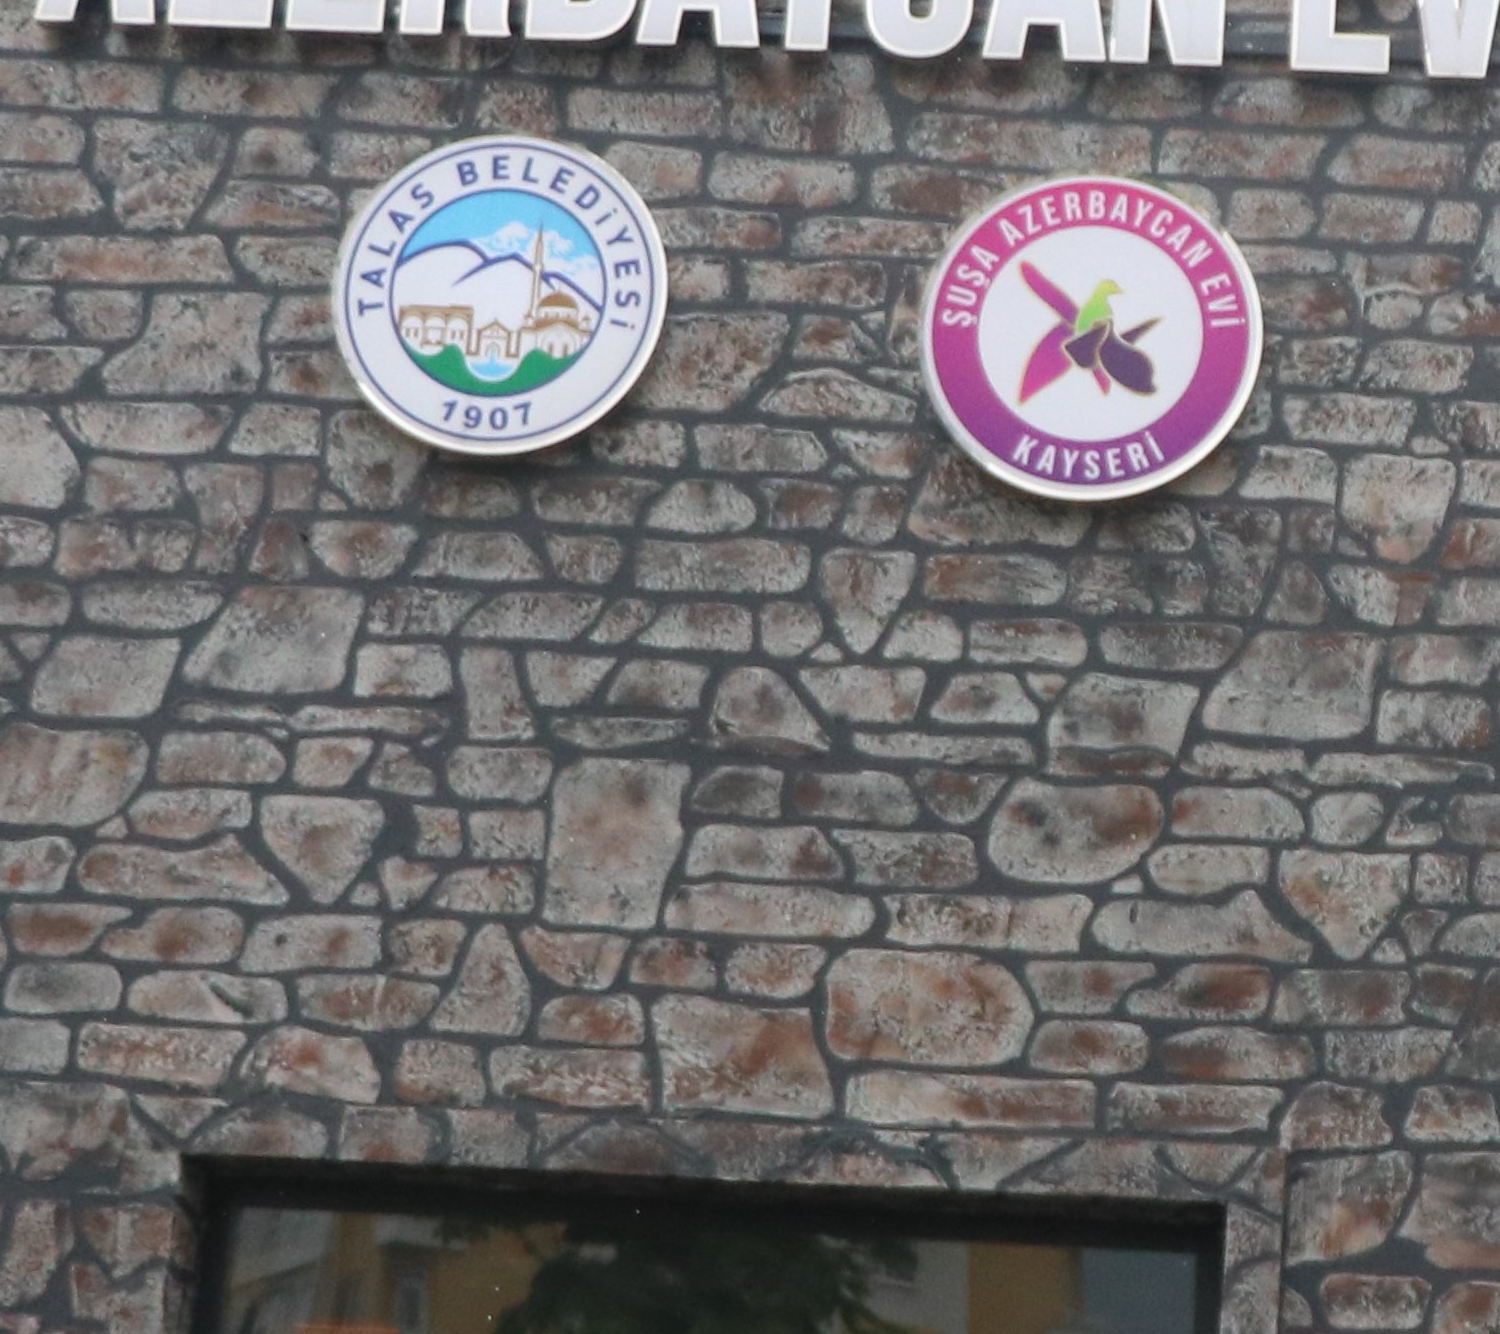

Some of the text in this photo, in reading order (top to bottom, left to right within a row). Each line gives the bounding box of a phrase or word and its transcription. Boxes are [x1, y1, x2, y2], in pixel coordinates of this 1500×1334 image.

[357, 182, 436, 317] TALAS
[940, 190, 1246, 329] ŞUŞA AZERBAYCAN EVİ
[441, 399, 532, 431] 1907
[1012, 430, 1166, 482] KAYSERİ
